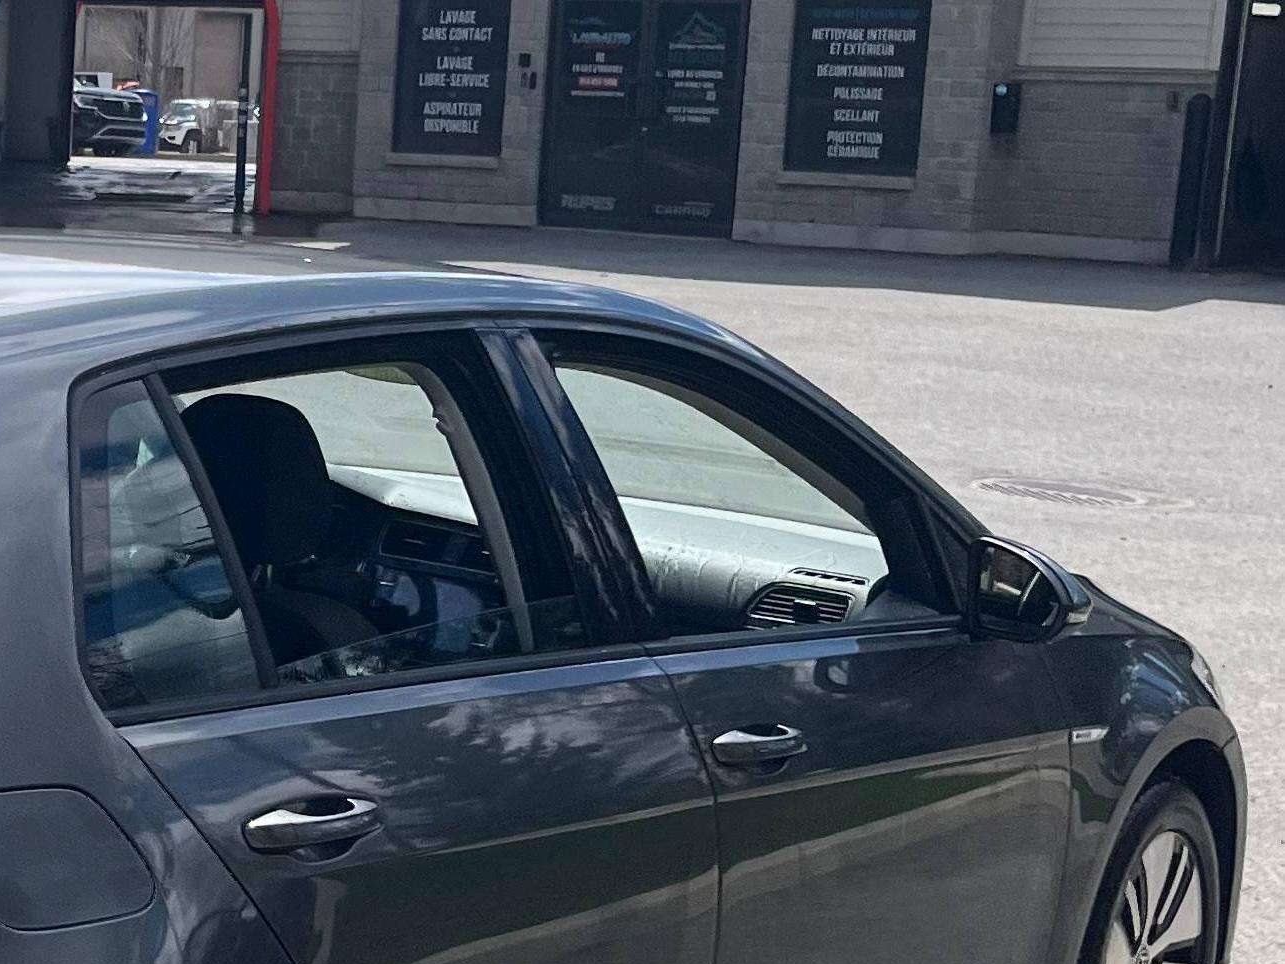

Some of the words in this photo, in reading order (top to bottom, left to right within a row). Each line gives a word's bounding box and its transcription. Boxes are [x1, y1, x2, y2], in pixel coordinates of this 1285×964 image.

[440, 10, 476, 24] LAVAGE
[422, 27, 447, 41] SANS
[449, 27, 493, 41] CONTACT
[812, 27, 865, 41] NETTOYAGE
[830, 42, 842, 55] ET
[437, 56, 474, 70] LAVAGE
[419, 73, 490, 88] LIBRE-SERVICE
[423, 102, 482, 116] ASPIRATEUR
